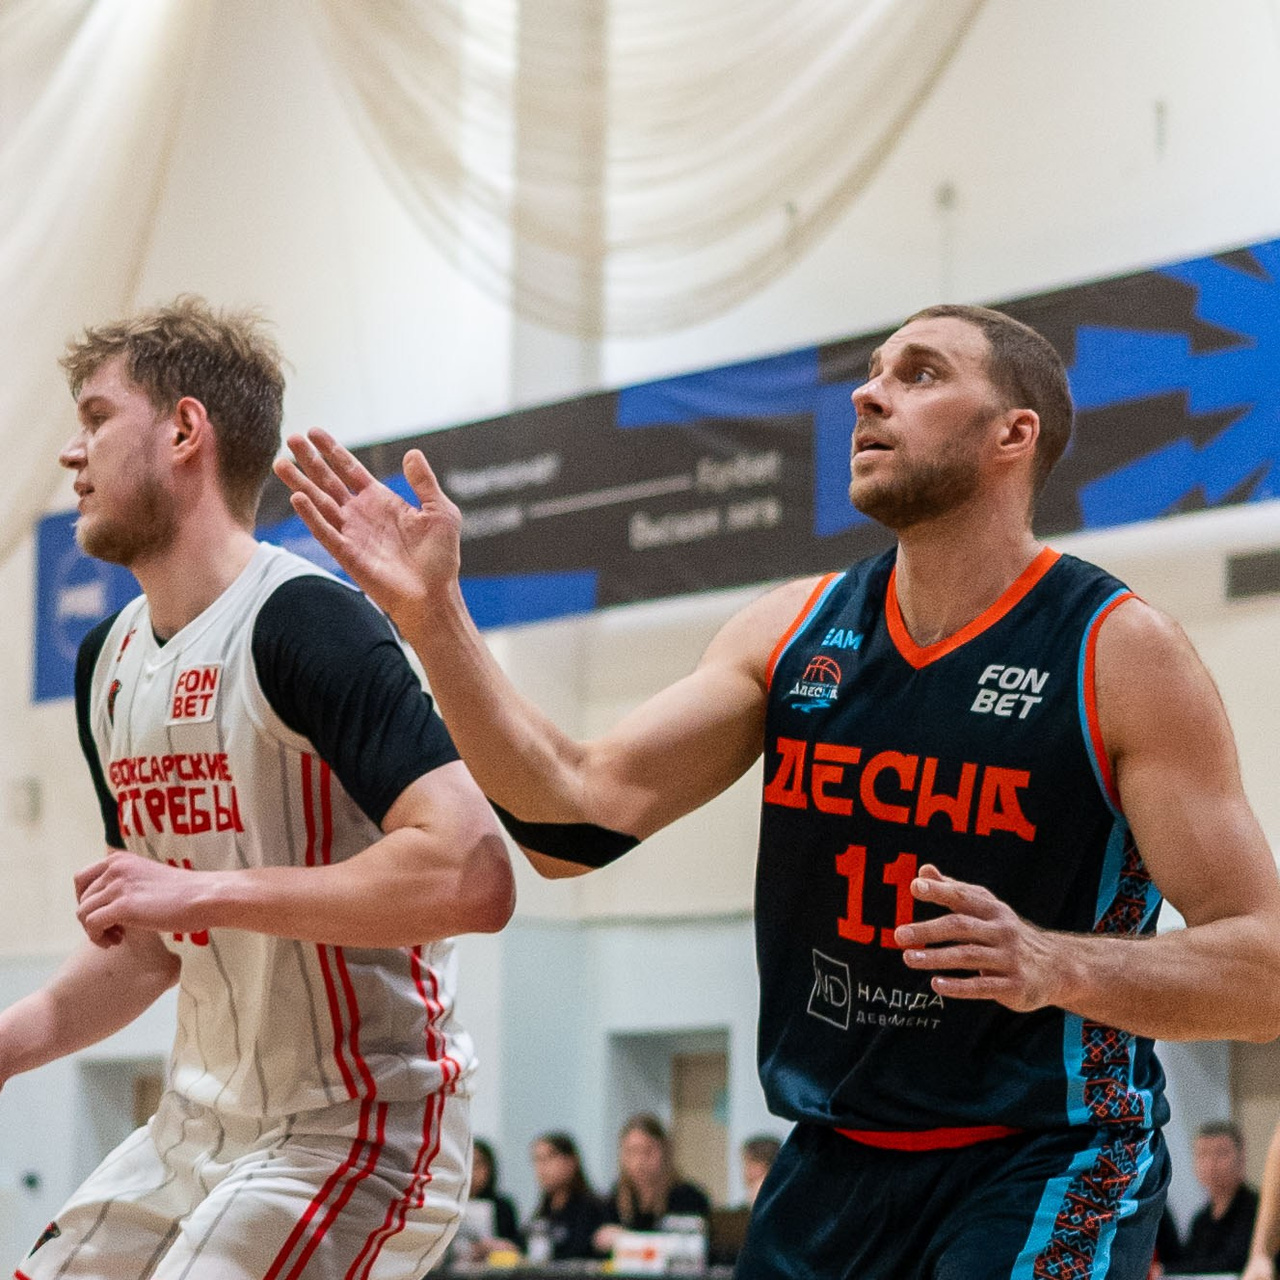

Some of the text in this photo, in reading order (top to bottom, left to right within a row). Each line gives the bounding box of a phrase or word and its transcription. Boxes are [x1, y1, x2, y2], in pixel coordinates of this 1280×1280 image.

[821, 627, 864, 651] EAM
[175, 667, 218, 695] FON
[977, 664, 1050, 694] FON
[172, 693, 214, 719] BET
[970, 688, 1043, 720] BET
[764, 736, 1037, 842] ДЕСНА
[117, 785, 245, 837] СТРЕБЫ
[835, 845, 926, 949] 11
